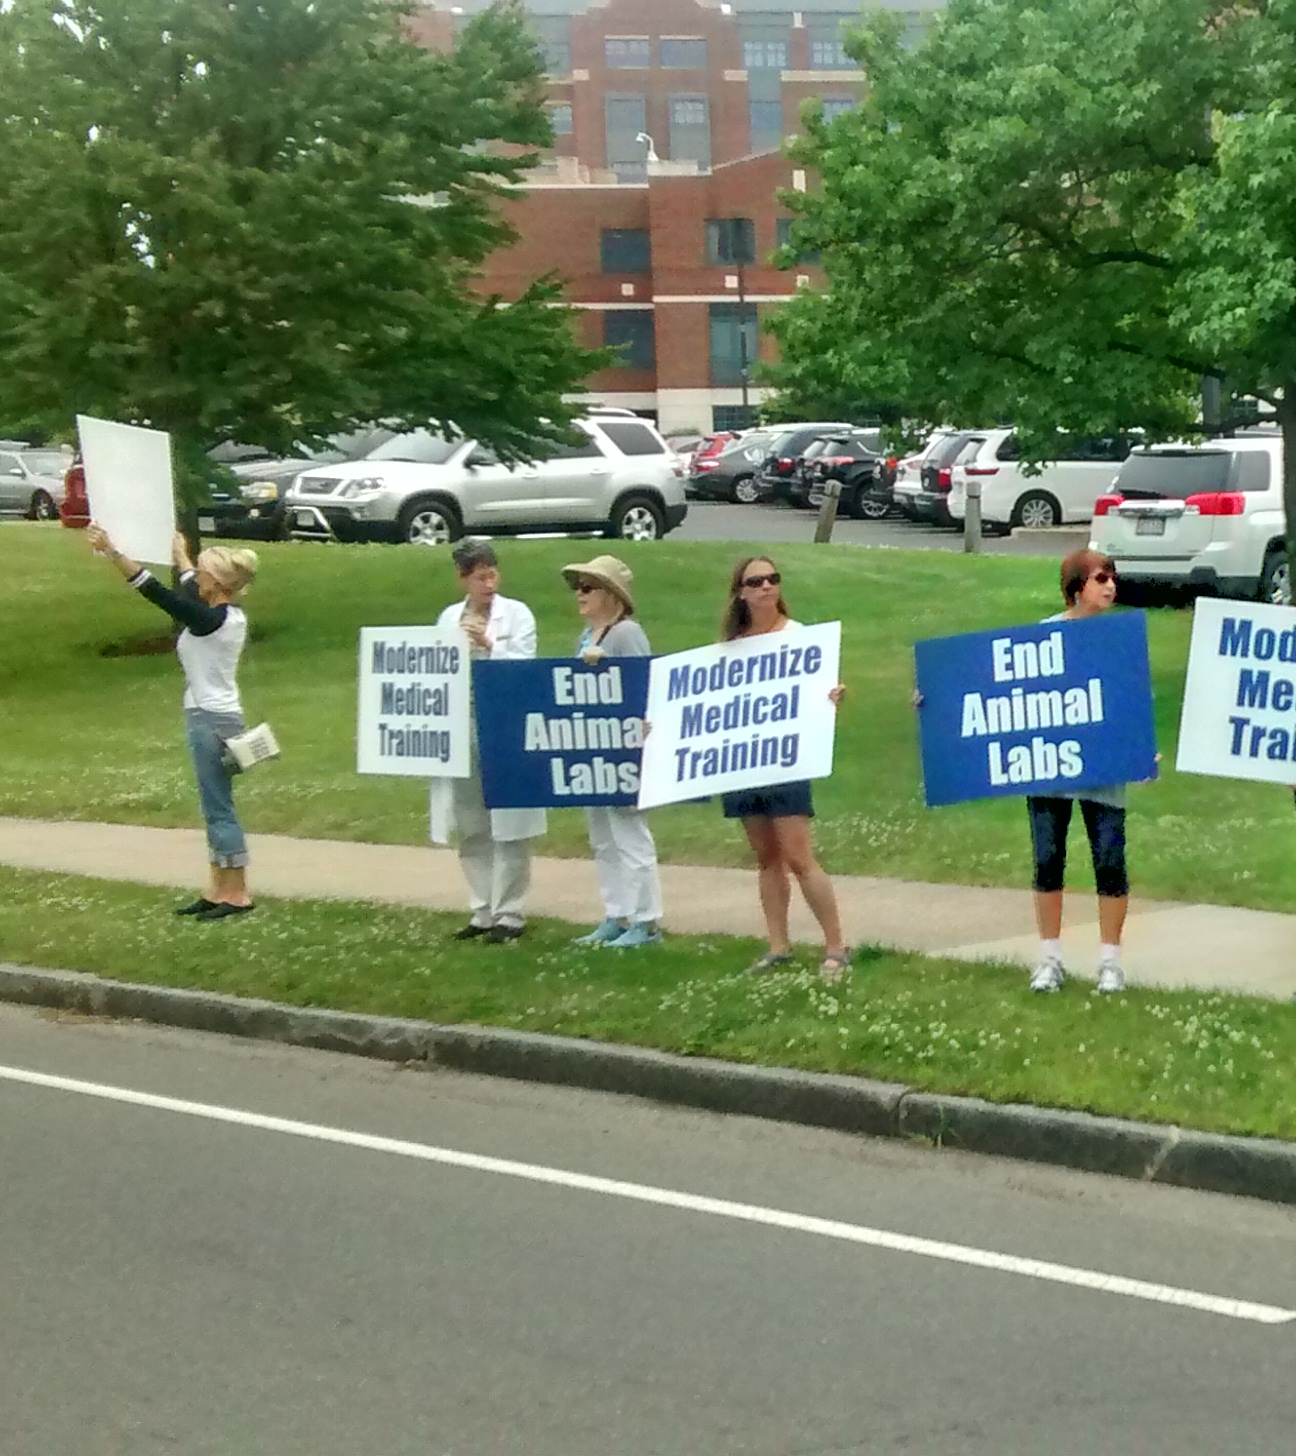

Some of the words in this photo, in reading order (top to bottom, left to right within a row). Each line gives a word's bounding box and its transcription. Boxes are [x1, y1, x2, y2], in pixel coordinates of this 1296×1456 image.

[372, 640, 460, 675] Modernize
[667, 644, 822, 701] Modernize
[992, 632, 1064, 683] End
[380, 682, 449, 716] Medical
[552, 666, 623, 705] End
[961, 678, 1104, 738] Animal
[524, 712, 643, 751] Anima
[680, 684, 801, 740] Medical
[378, 723, 451, 763] Training
[675, 733, 800, 783] Training
[988, 736, 1083, 786] Labs
[551, 756, 640, 796] Labs
